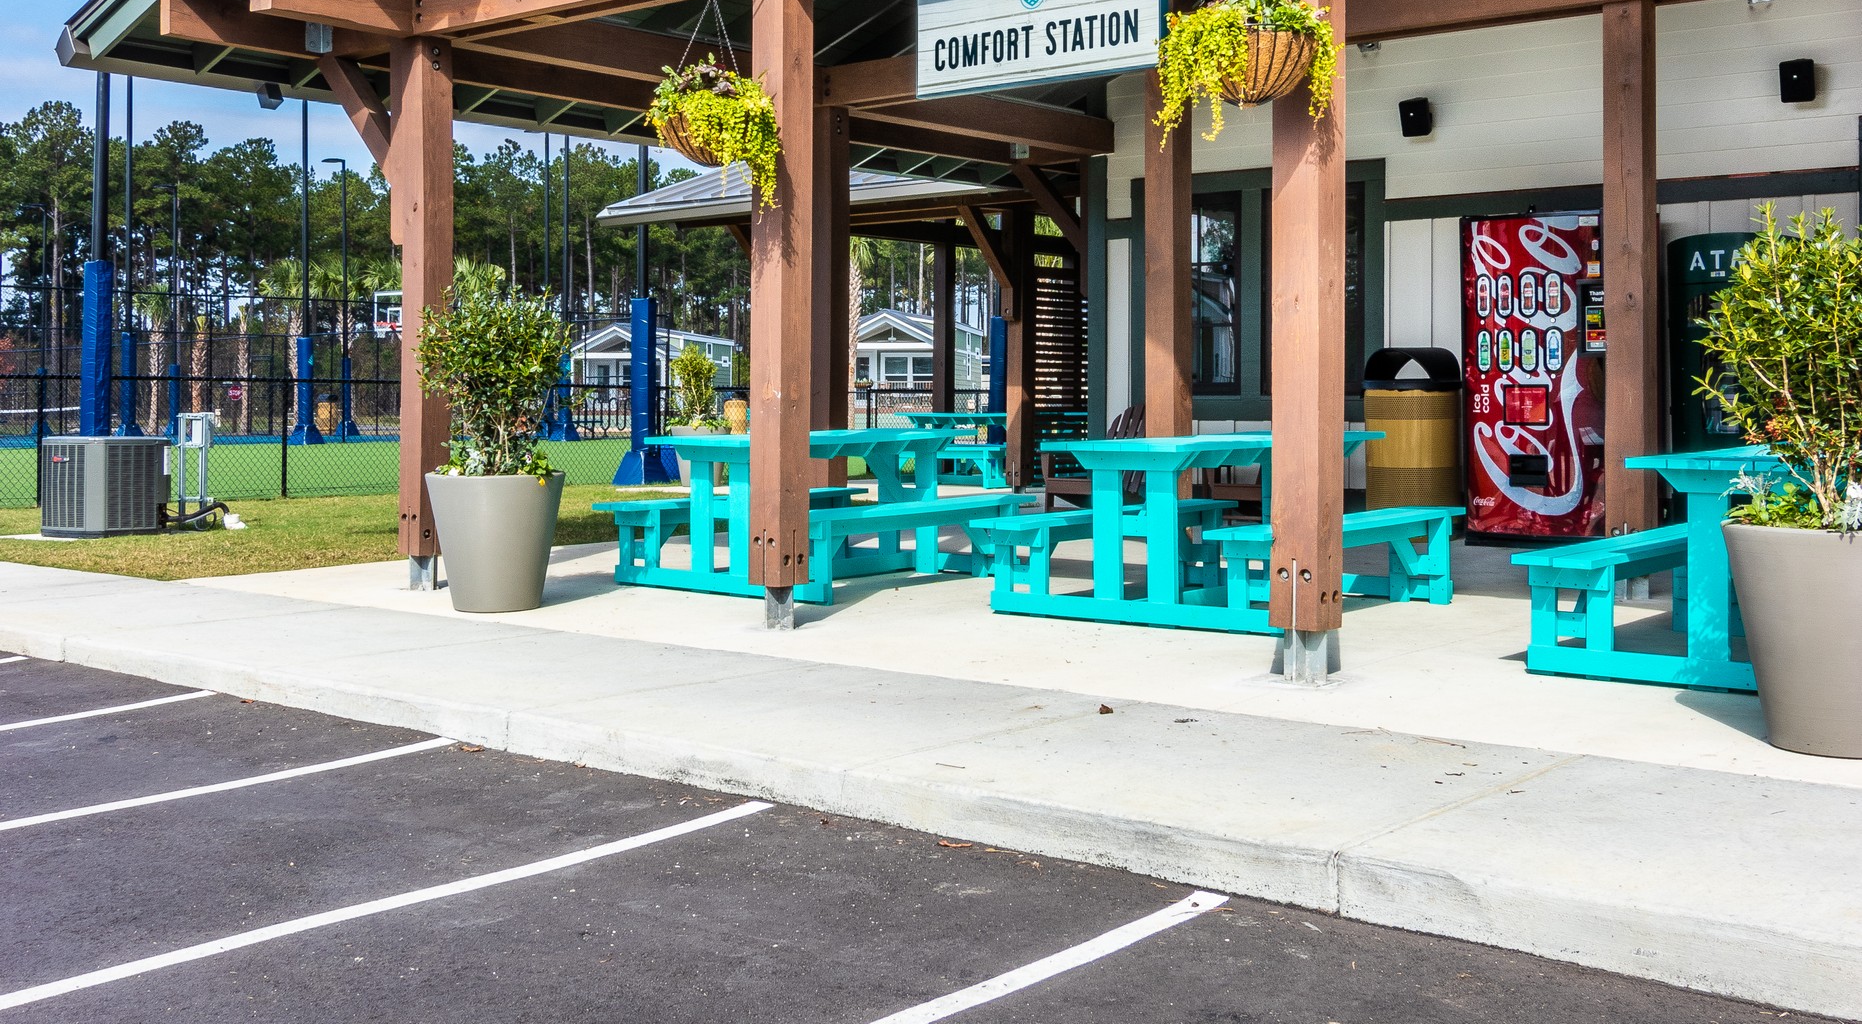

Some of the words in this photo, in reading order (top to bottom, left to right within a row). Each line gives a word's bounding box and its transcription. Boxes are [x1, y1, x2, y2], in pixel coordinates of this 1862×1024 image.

[934, 24, 1034, 71] COMFORT
[1045, 8, 1139, 56] STATION
[1481, 384, 1490, 413] cold
